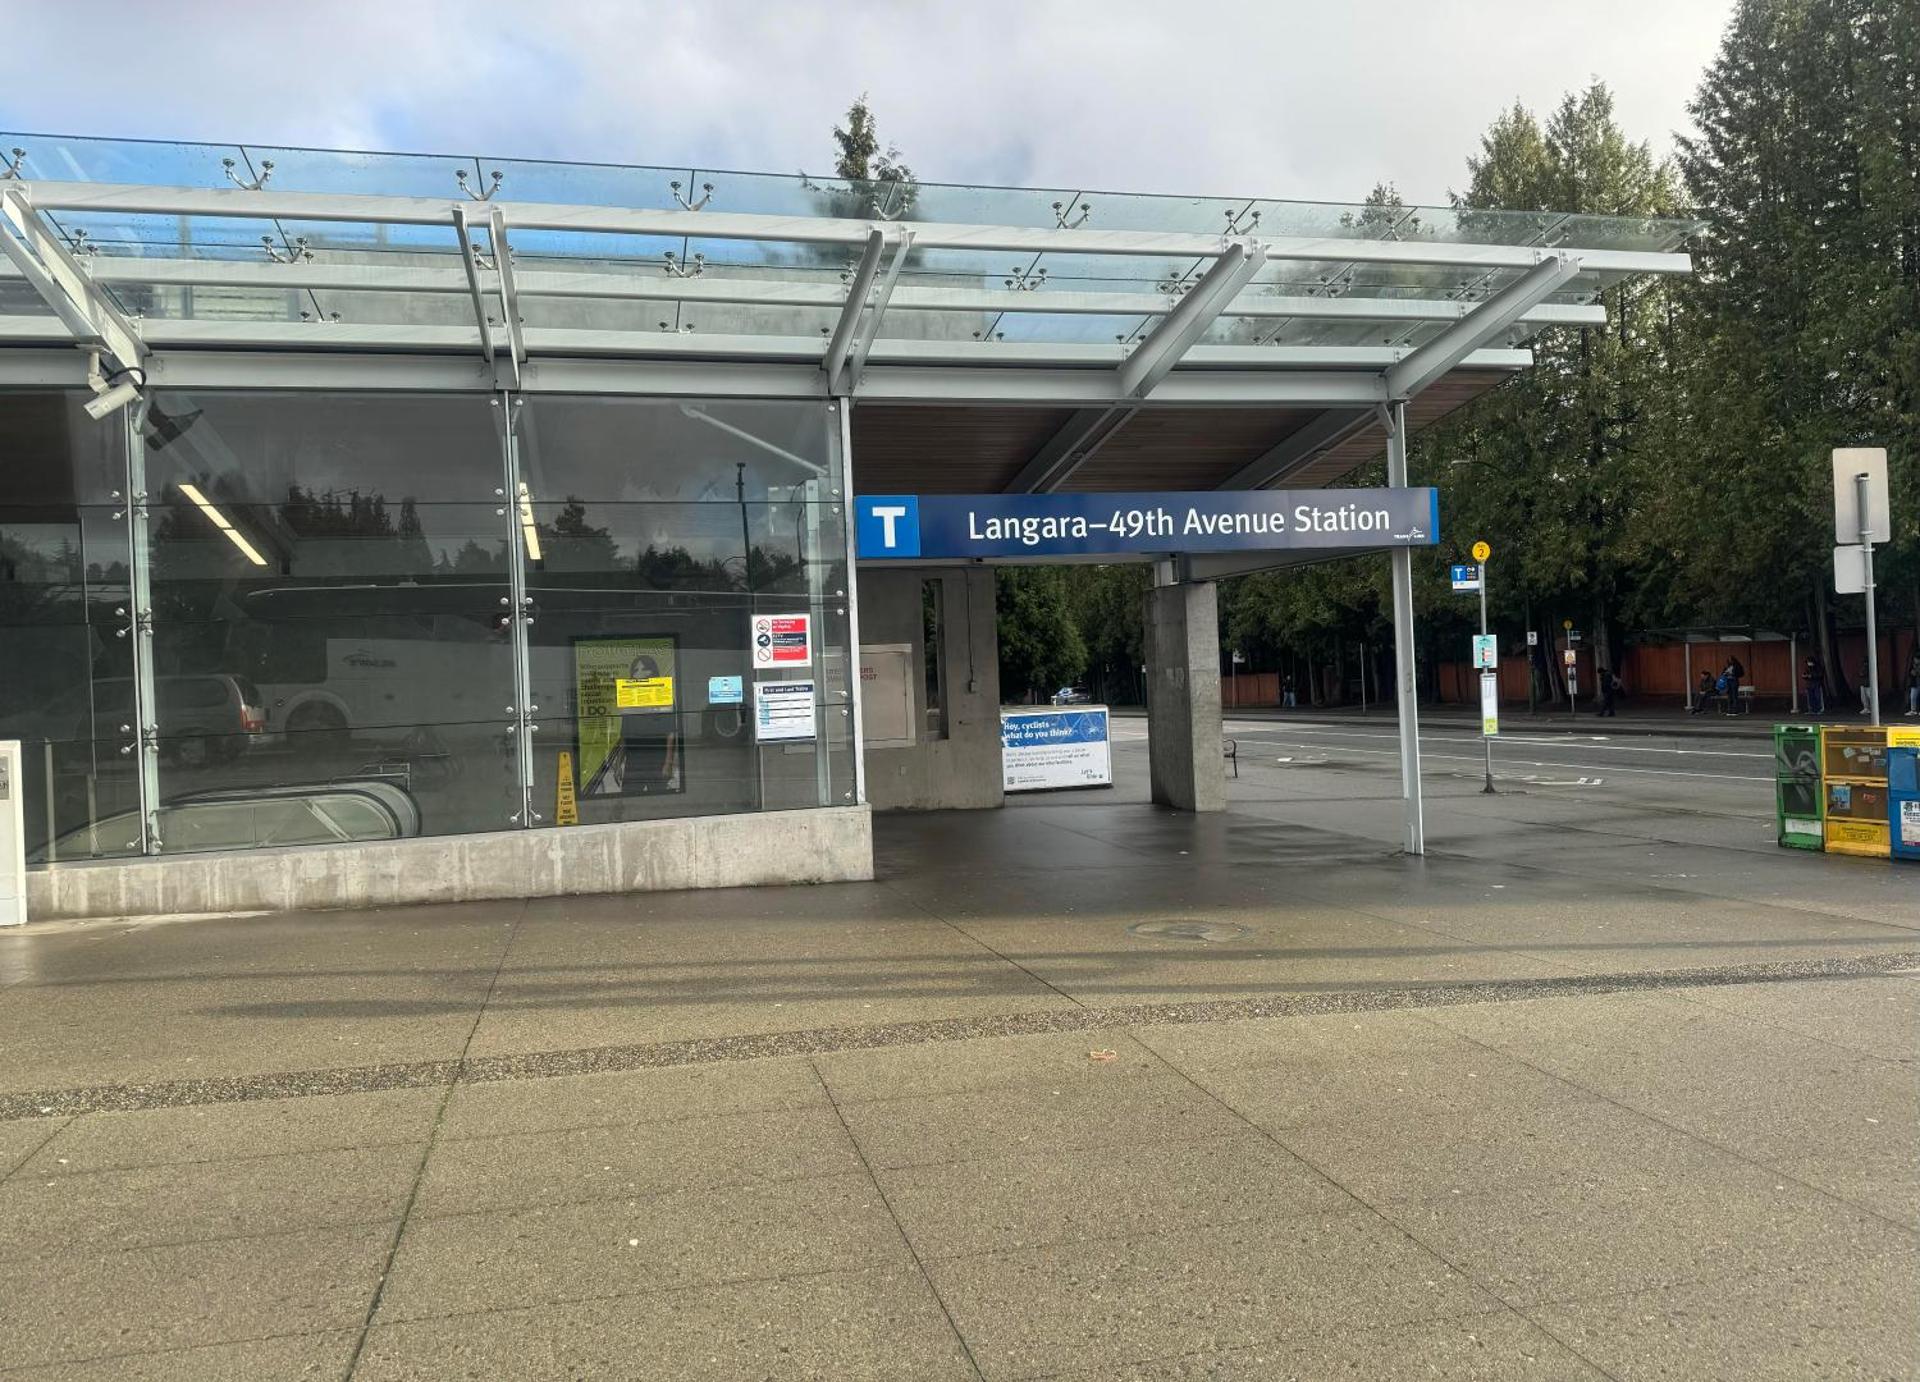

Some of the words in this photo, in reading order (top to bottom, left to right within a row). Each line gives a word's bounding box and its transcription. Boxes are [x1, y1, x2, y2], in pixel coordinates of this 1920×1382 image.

[872, 506, 906, 548] T
[968, 507, 1174, 546] Langara–49th
[1183, 507, 1285, 535] Avenue
[1294, 503, 1390, 532] Station
[1022, 719, 1050, 730] cyclists
[1024, 729, 1034, 738] do
[1035, 731, 1049, 740] you
